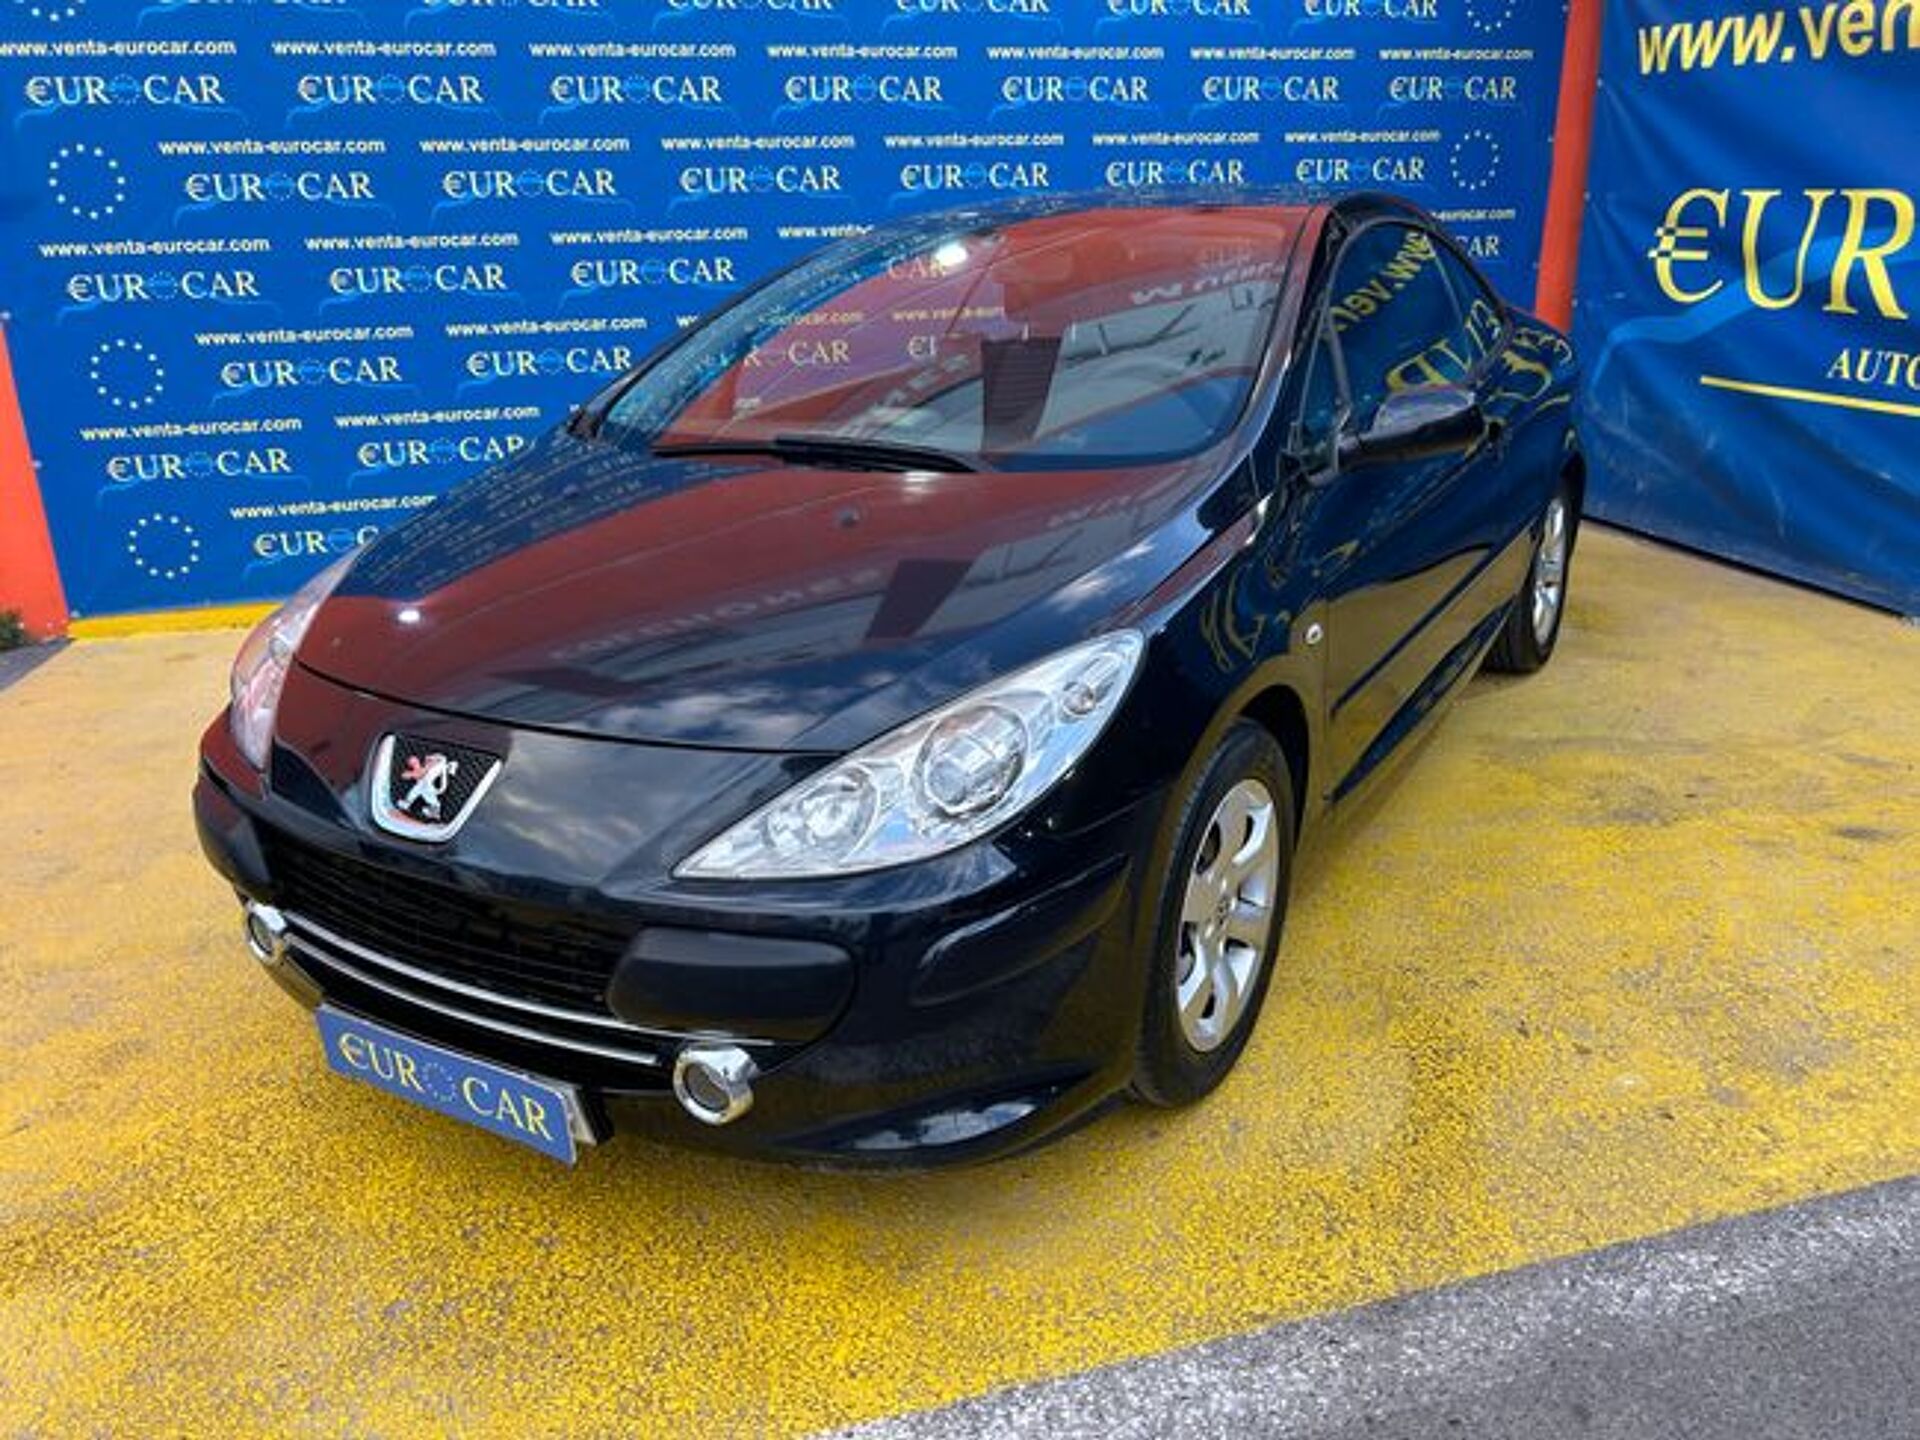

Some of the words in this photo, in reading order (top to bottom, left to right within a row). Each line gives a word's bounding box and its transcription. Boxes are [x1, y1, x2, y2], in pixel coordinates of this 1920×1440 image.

[271, 40, 496, 57] www.venta-eurocar.com
[529, 42, 736, 58] www.venta-eurocar.com
[767, 44, 958, 59] www.venta-eurocar.com
[987, 46, 1164, 60] www.venta-eurocar.com
[419, 137, 630, 152] www.venta-eurocar.com
[661, 135, 855, 150] www.venta-eurocar.com
[885, 133, 1064, 147] www.venta-eurocar.com
[1092, 132, 1259, 145] www.venta-eurocar.com
[1284, 131, 1439, 143] www.venta-eurocar.com
[158, 139, 386, 155] www.venta-eurocar.com
[305, 233, 518, 250] www.venta-eurocar.com
[551, 227, 748, 244] www.venta-eurocar.com
[40, 238, 270, 257] www.venta-eurocar.com
[445, 318, 647, 336] www.venta-eurocar.com
[195, 326, 414, 345] www.venta-eurocar.com
[335, 406, 539, 427] www.venta-eurocar.com
[80, 418, 302, 441] www.venta-eurocar.com
